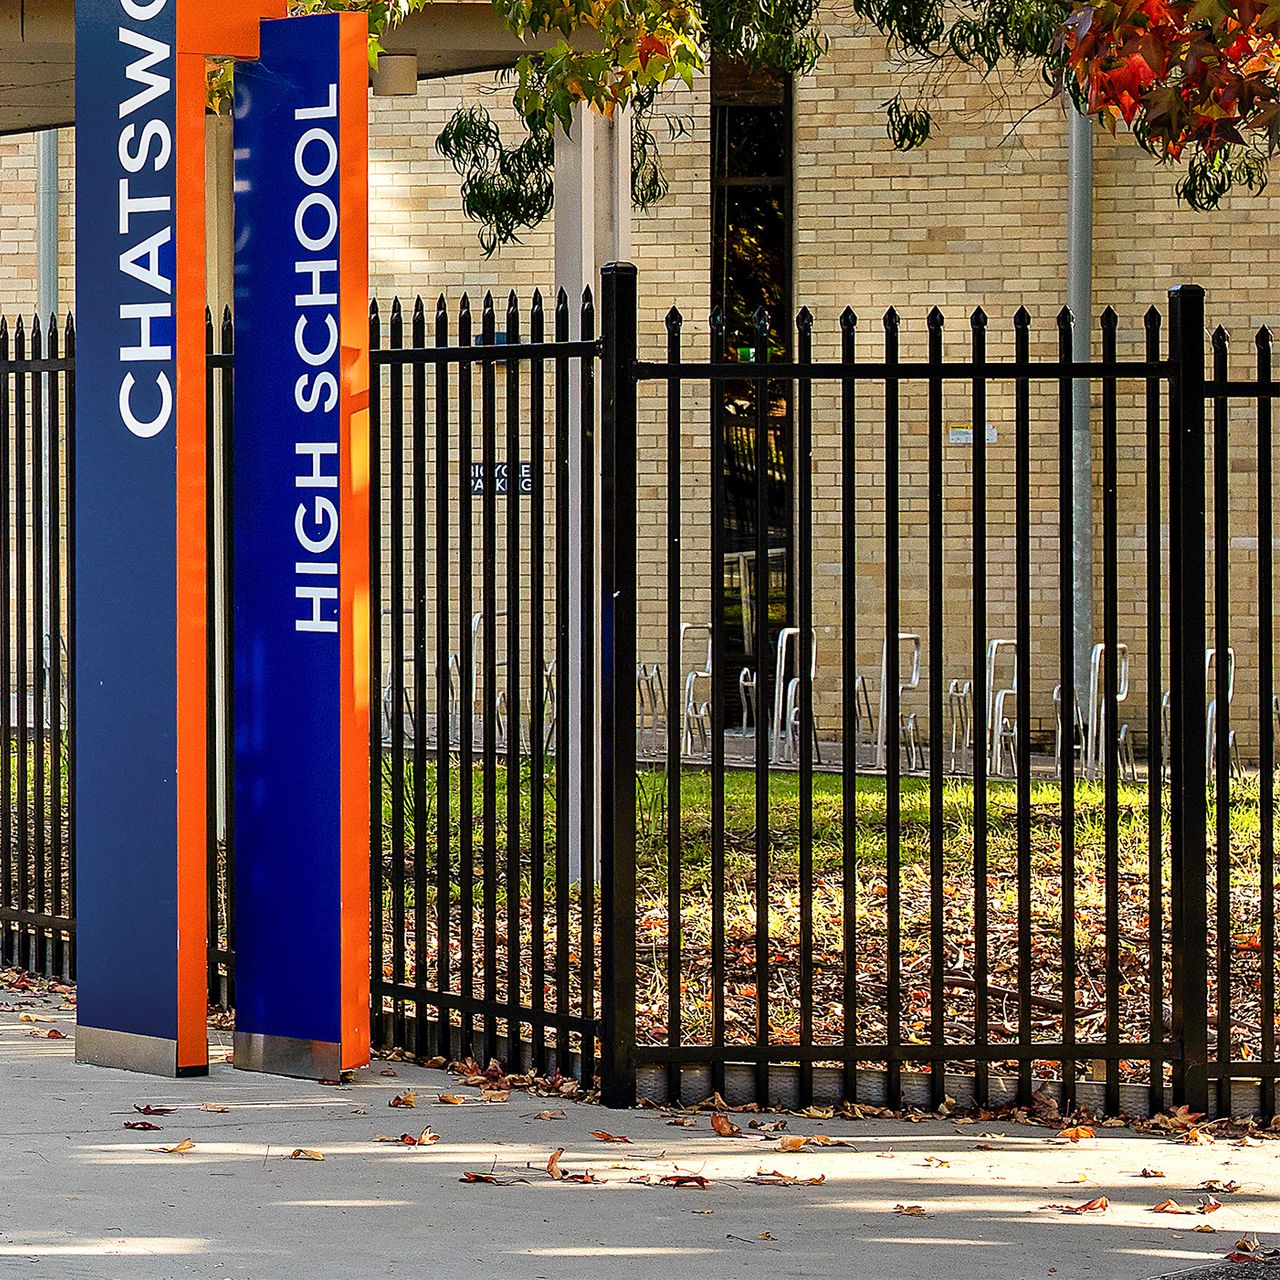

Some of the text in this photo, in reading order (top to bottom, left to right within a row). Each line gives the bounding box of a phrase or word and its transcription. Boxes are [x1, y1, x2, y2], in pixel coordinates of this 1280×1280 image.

[294, 83, 339, 633] HIGH SCHOOL
[470, 464, 531, 477] BIYCE
[470, 478, 532, 491] AKIG
